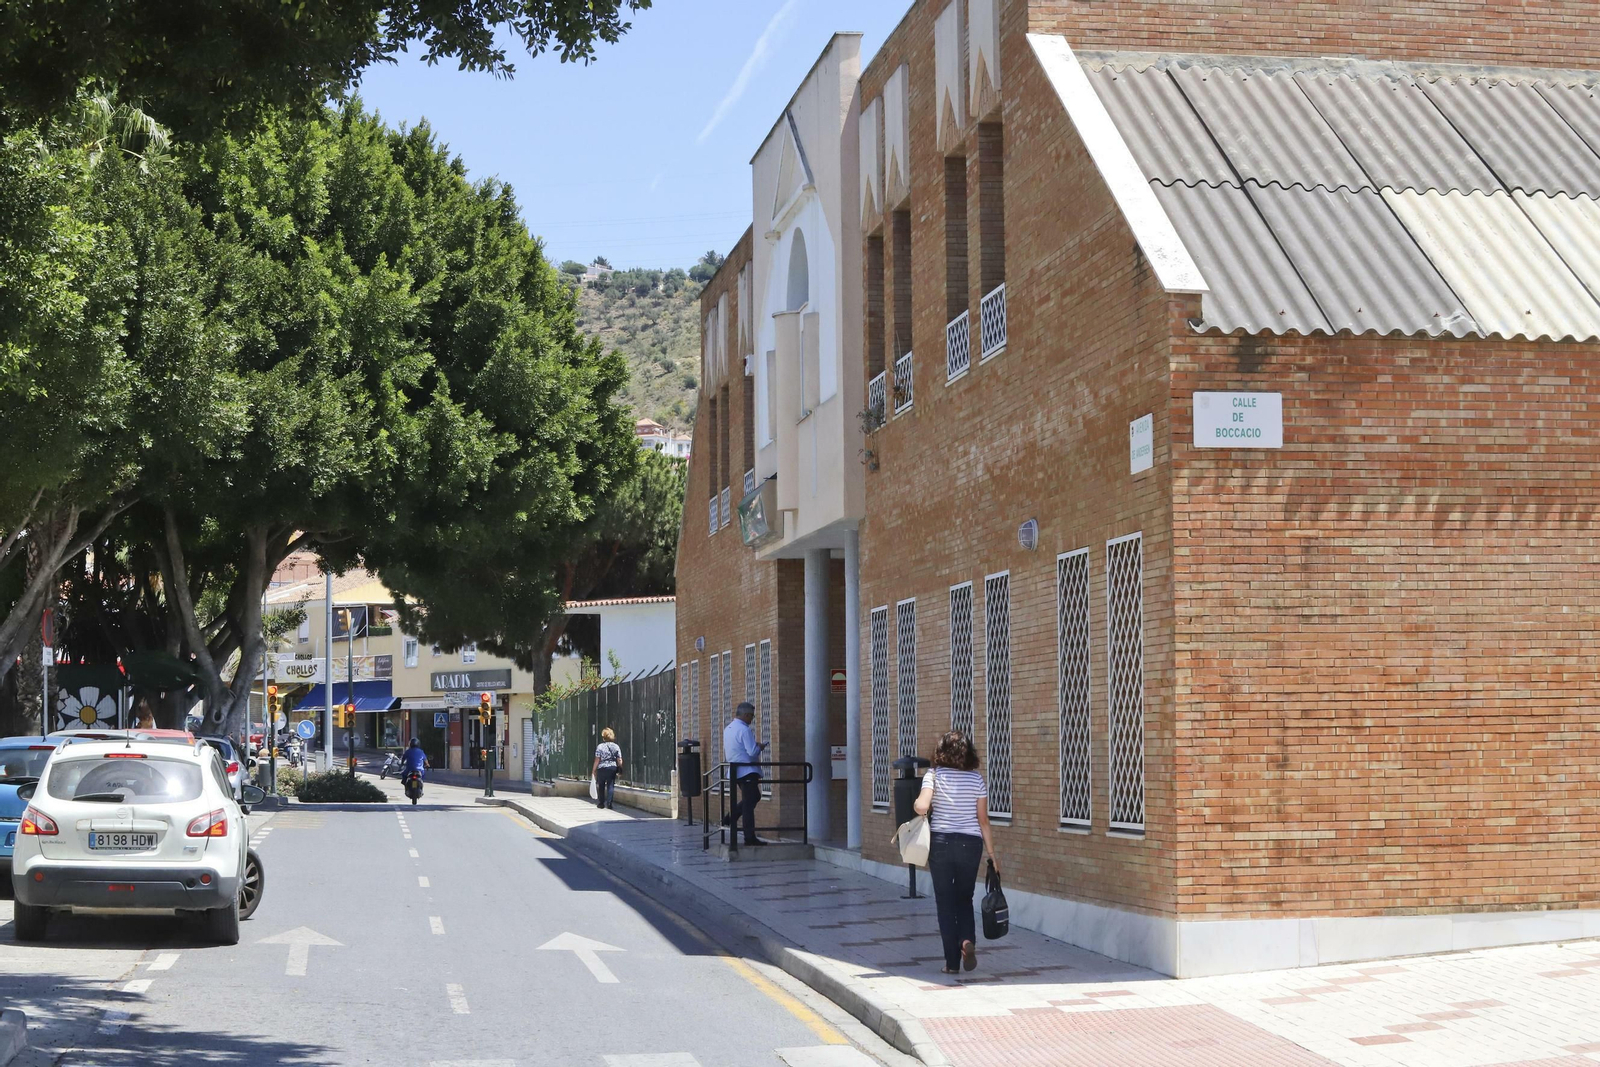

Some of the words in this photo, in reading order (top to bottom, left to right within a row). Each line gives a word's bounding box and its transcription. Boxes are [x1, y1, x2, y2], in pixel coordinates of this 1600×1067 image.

[1232, 397, 1257, 408] CALLE
[1232, 412, 1244, 422] DE
[1215, 427, 1261, 438] BOCCACIO
[286, 664, 318, 676] CHOLLOS
[434, 673, 471, 689] ARADIS
[97, 834, 127, 846] 8198
[131, 834, 154, 846] HDW
